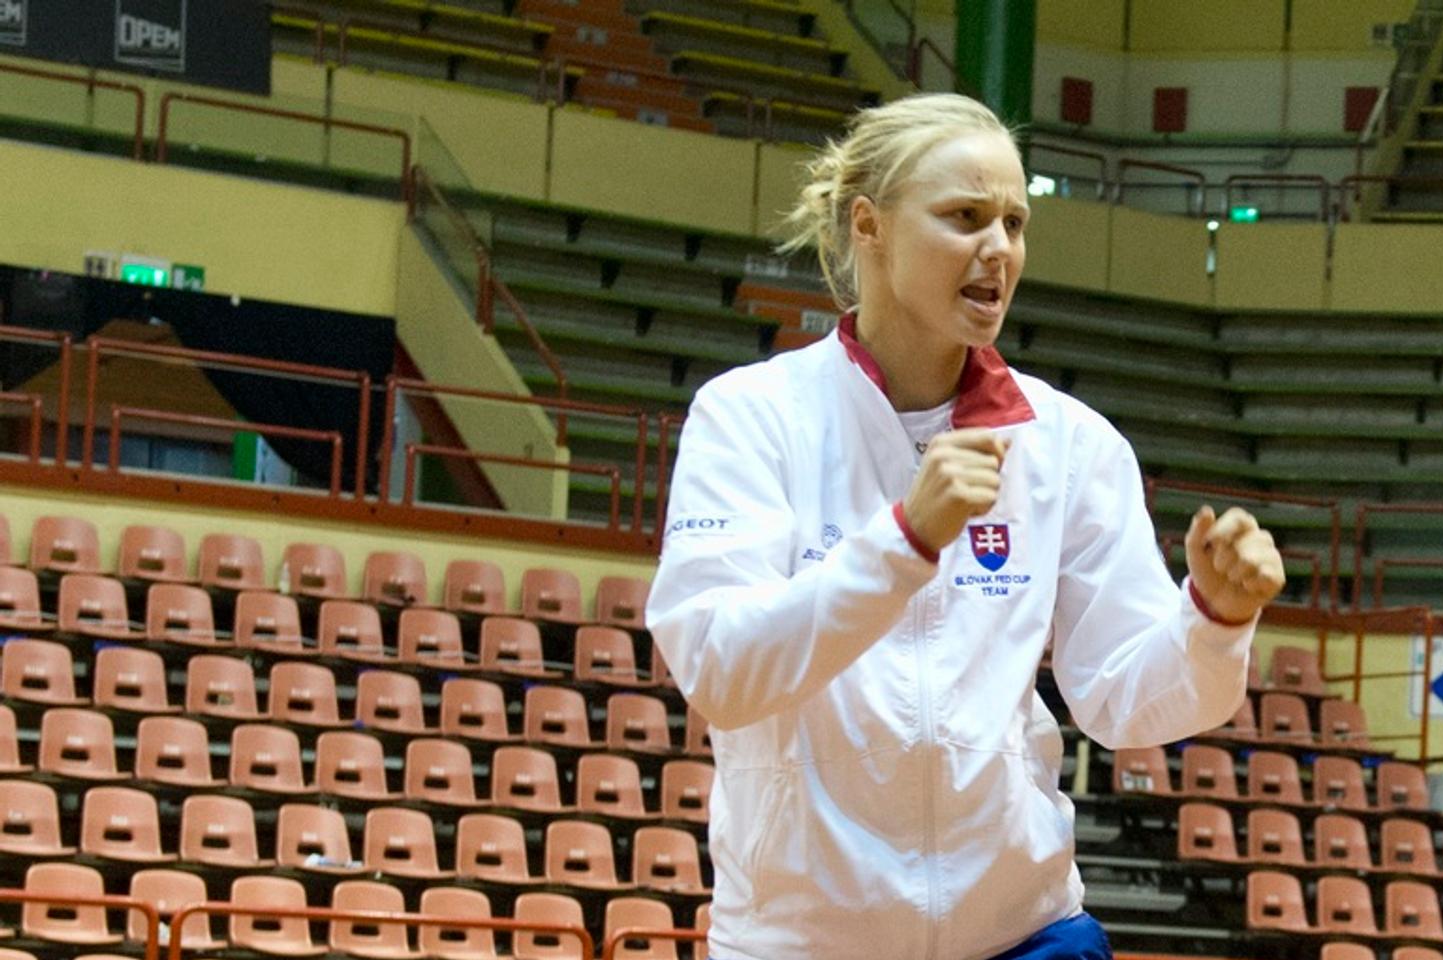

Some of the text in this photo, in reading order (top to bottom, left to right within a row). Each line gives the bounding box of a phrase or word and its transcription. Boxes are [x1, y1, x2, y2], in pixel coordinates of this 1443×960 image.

[667, 518, 730, 536] GEOT
[955, 574, 1031, 586] SLOVAK FED CUP
[981, 586, 1009, 597] TEAM
